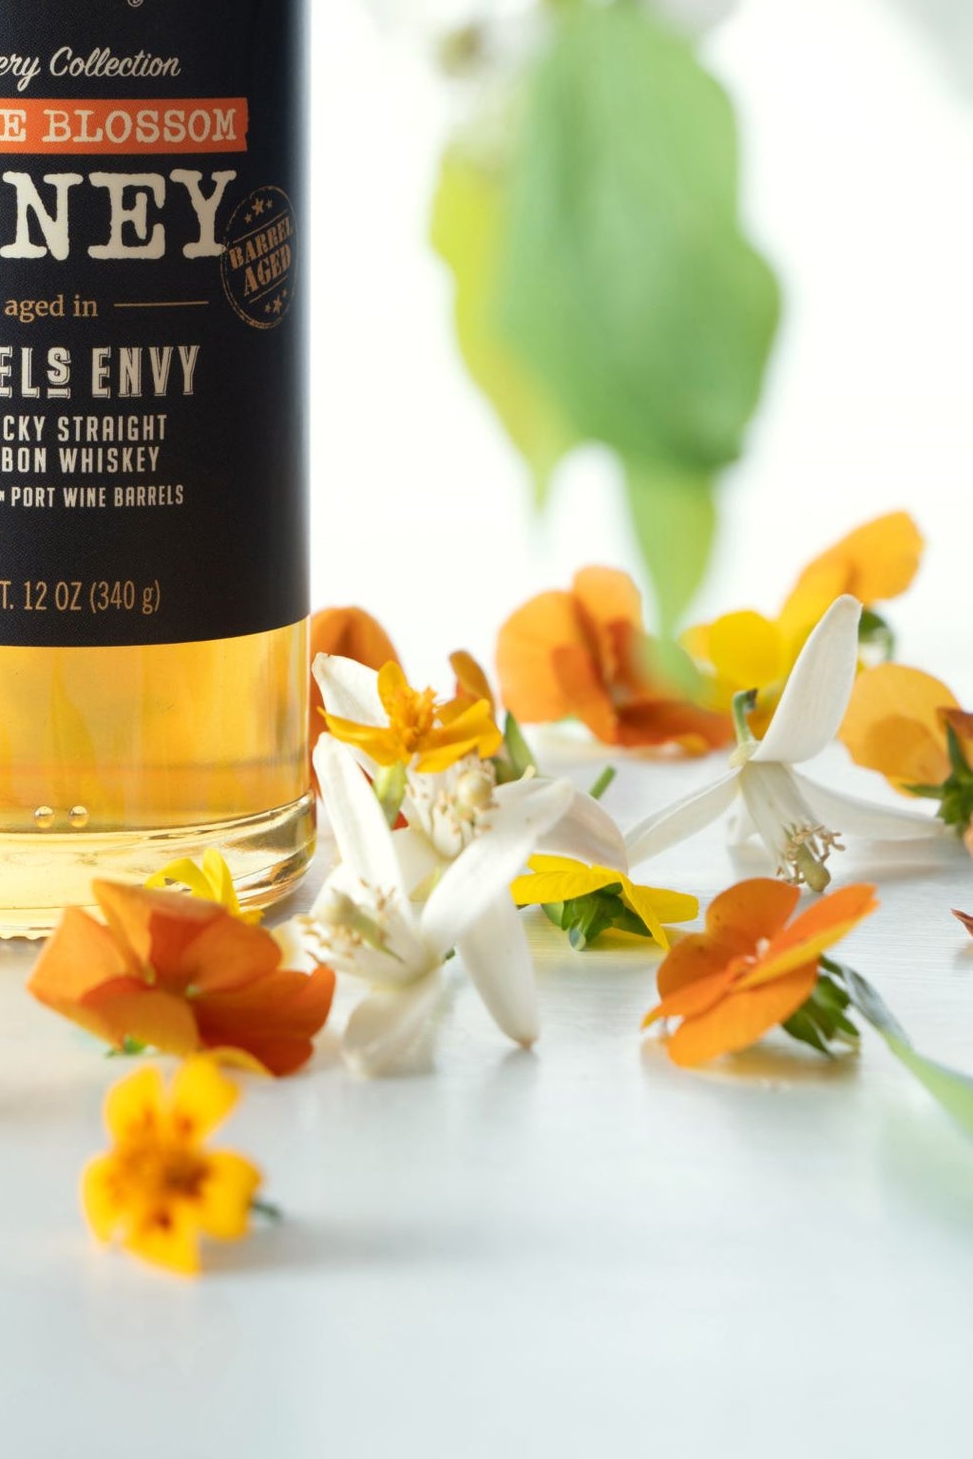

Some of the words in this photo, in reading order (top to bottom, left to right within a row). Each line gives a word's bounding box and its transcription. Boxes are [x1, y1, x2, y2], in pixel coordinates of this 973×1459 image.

[49, 46, 181, 77] Collection
[42, 108, 237, 143] BLOSSOM
[229, 217, 294, 268] BARREL
[243, 251, 291, 296] AGED
[4, 297, 65, 323] aged
[73, 297, 98, 317] in
[92, 345, 200, 398] ENVY
[58, 415, 168, 442] STRAIGHT
[60, 447, 160, 473] WHISKEY
[11, 487, 54, 507] PORT
[64, 488, 106, 507] WINE
[114, 485, 184, 506] BARRELS
[24, 580, 45, 610] 12
[90, 580, 135, 612] (340
[142, 580, 161, 613] g)
